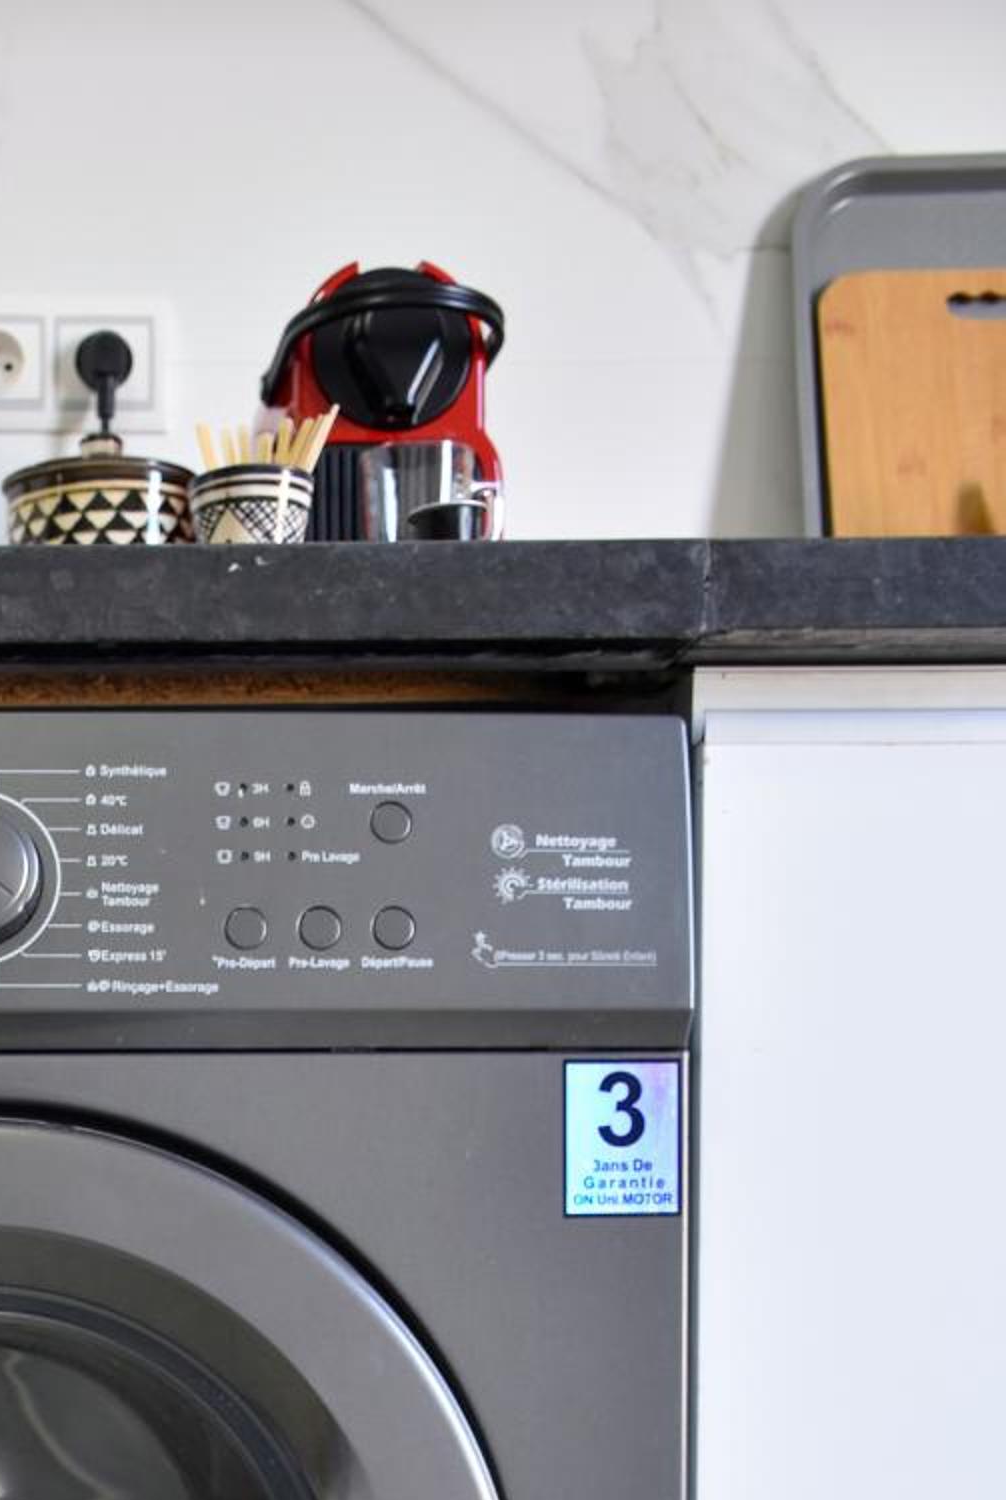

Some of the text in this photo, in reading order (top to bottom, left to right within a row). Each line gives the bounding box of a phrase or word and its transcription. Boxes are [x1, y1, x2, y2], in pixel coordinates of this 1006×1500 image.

[536, 834, 617, 850] Nettoyage
[562, 853, 632, 867] Tambour
[101, 881, 159, 896] Nettoyage
[537, 876, 629, 892] Stérilisation
[103, 895, 151, 907] Tambour
[563, 897, 632, 910] Tambour
[101, 920, 155, 936] Essorage
[101, 949, 147, 964] Express
[598, 1071, 646, 1147] 3
[633, 1158, 653, 1172] De
[583, 1175, 666, 1189] Garantie
